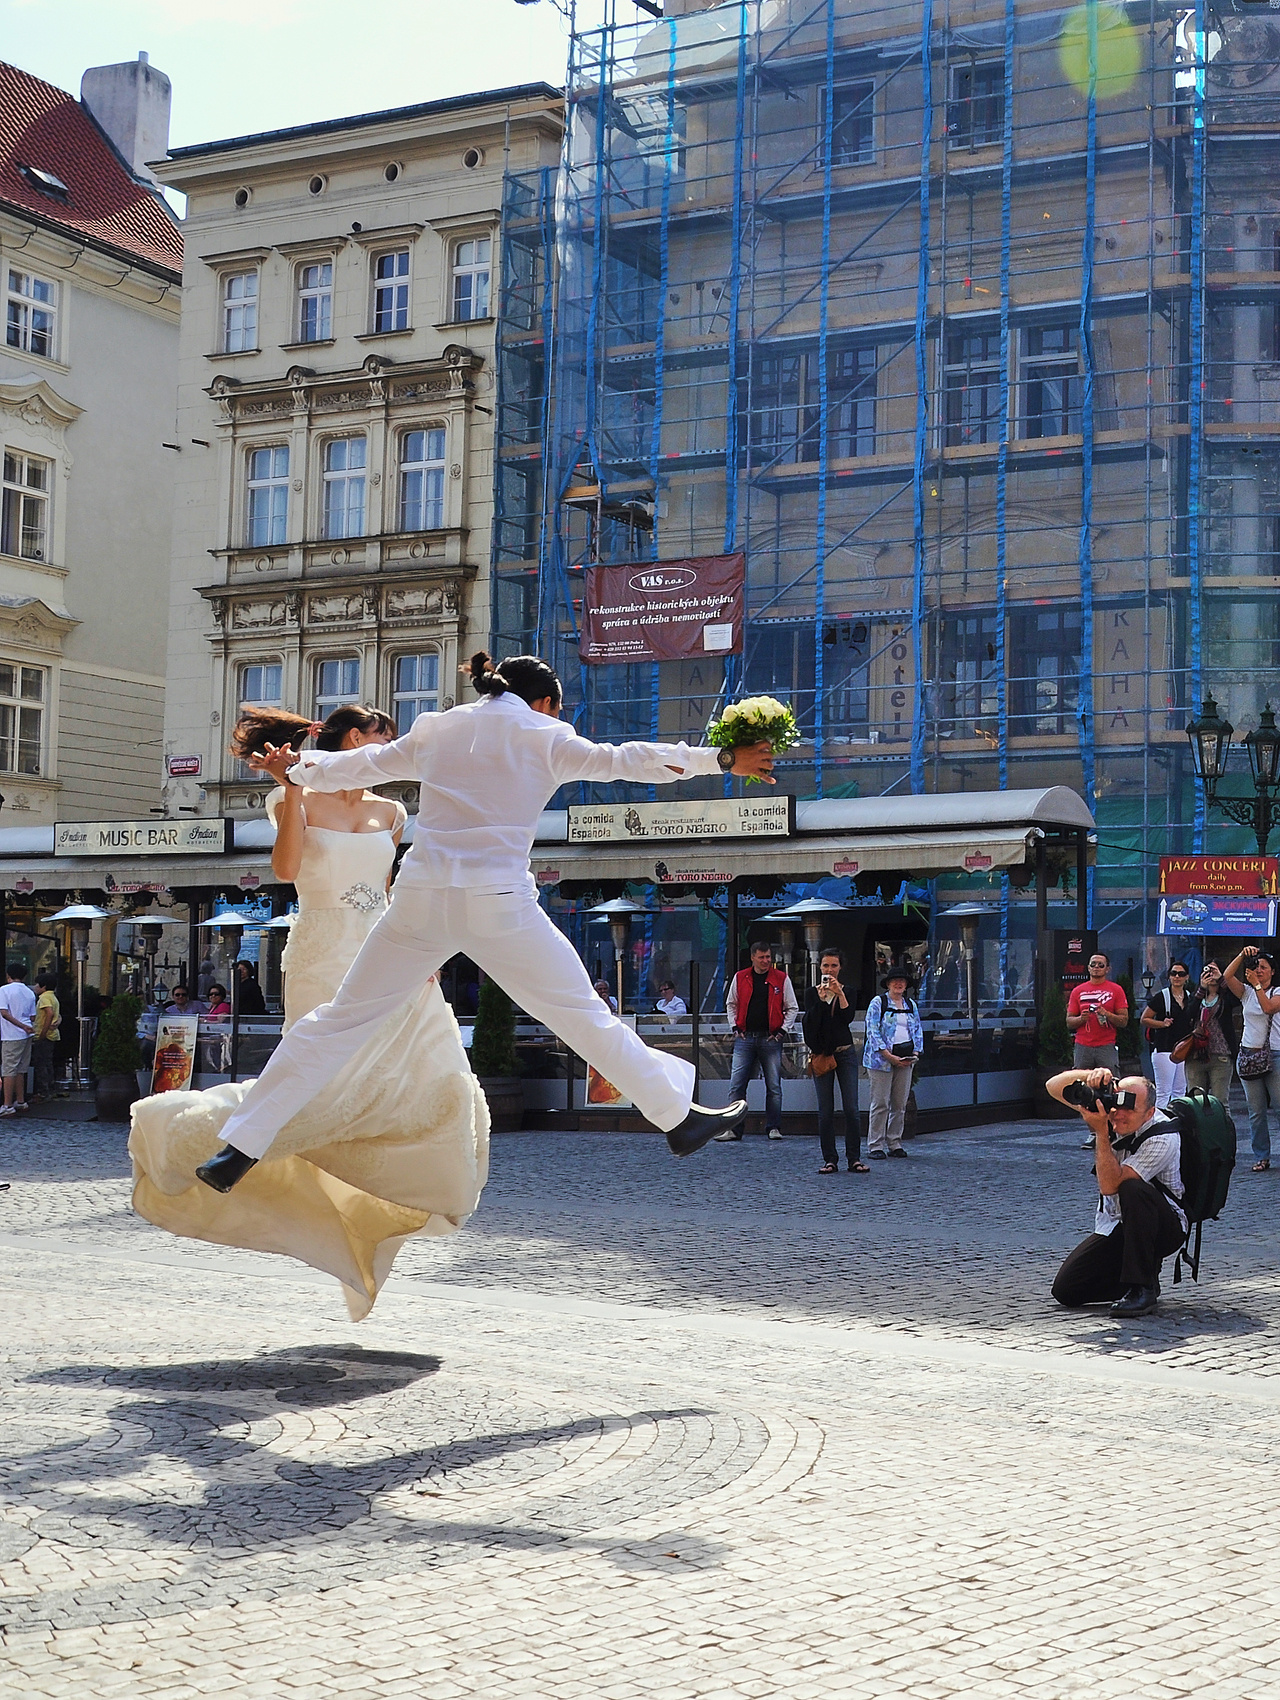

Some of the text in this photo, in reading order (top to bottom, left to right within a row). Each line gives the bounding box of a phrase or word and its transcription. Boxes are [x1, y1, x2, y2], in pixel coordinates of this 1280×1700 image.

[641, 575, 663, 587] VAS
[589, 603, 645, 615] rekonstrukce
[647, 597, 699, 610] historických
[632, 618, 638, 626] a
[739, 804, 786, 817] La comida
[582, 812, 614, 825] comida
[741, 818, 783, 832] Española
[189, 826, 219, 840] Indian
[571, 826, 611, 841] Española
[650, 825, 684, 836] TORO
[686, 823, 728, 834] NEGRO
[99, 829, 178, 847] MUSIC BAR
[1168, 861, 1268, 872] JAZZ CONCERT
[675, 873, 700, 881] TORO
[701, 873, 733, 881] NEGRO
[1207, 873, 1227, 882] daily
[1189, 882, 1208, 890] from
[1227, 884, 1245, 892] p.m.
